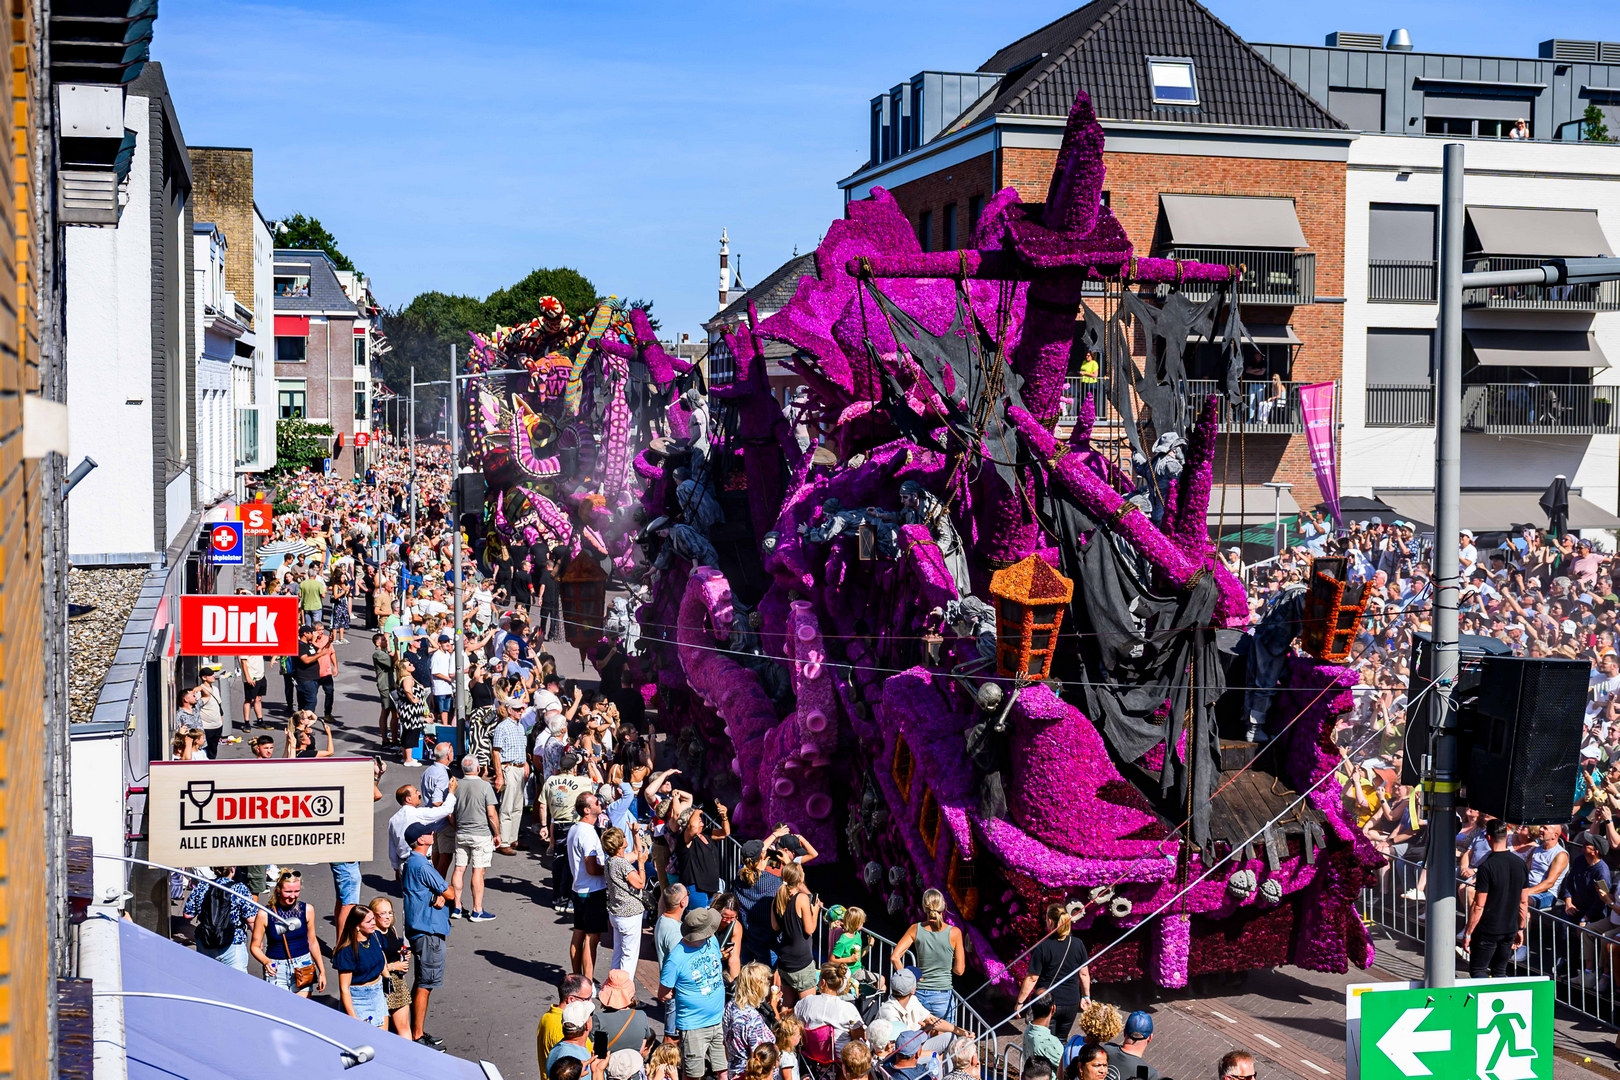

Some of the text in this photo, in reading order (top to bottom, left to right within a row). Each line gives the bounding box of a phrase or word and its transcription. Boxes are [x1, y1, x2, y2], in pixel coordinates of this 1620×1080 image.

[249, 510, 264, 527] S
[202, 605, 279, 643] Dirk
[548, 778, 579, 791] MILANO
[216, 795, 313, 820] DIRCK
[179, 832, 345, 850] ALLE DRANKEN GOEDKOPER!
